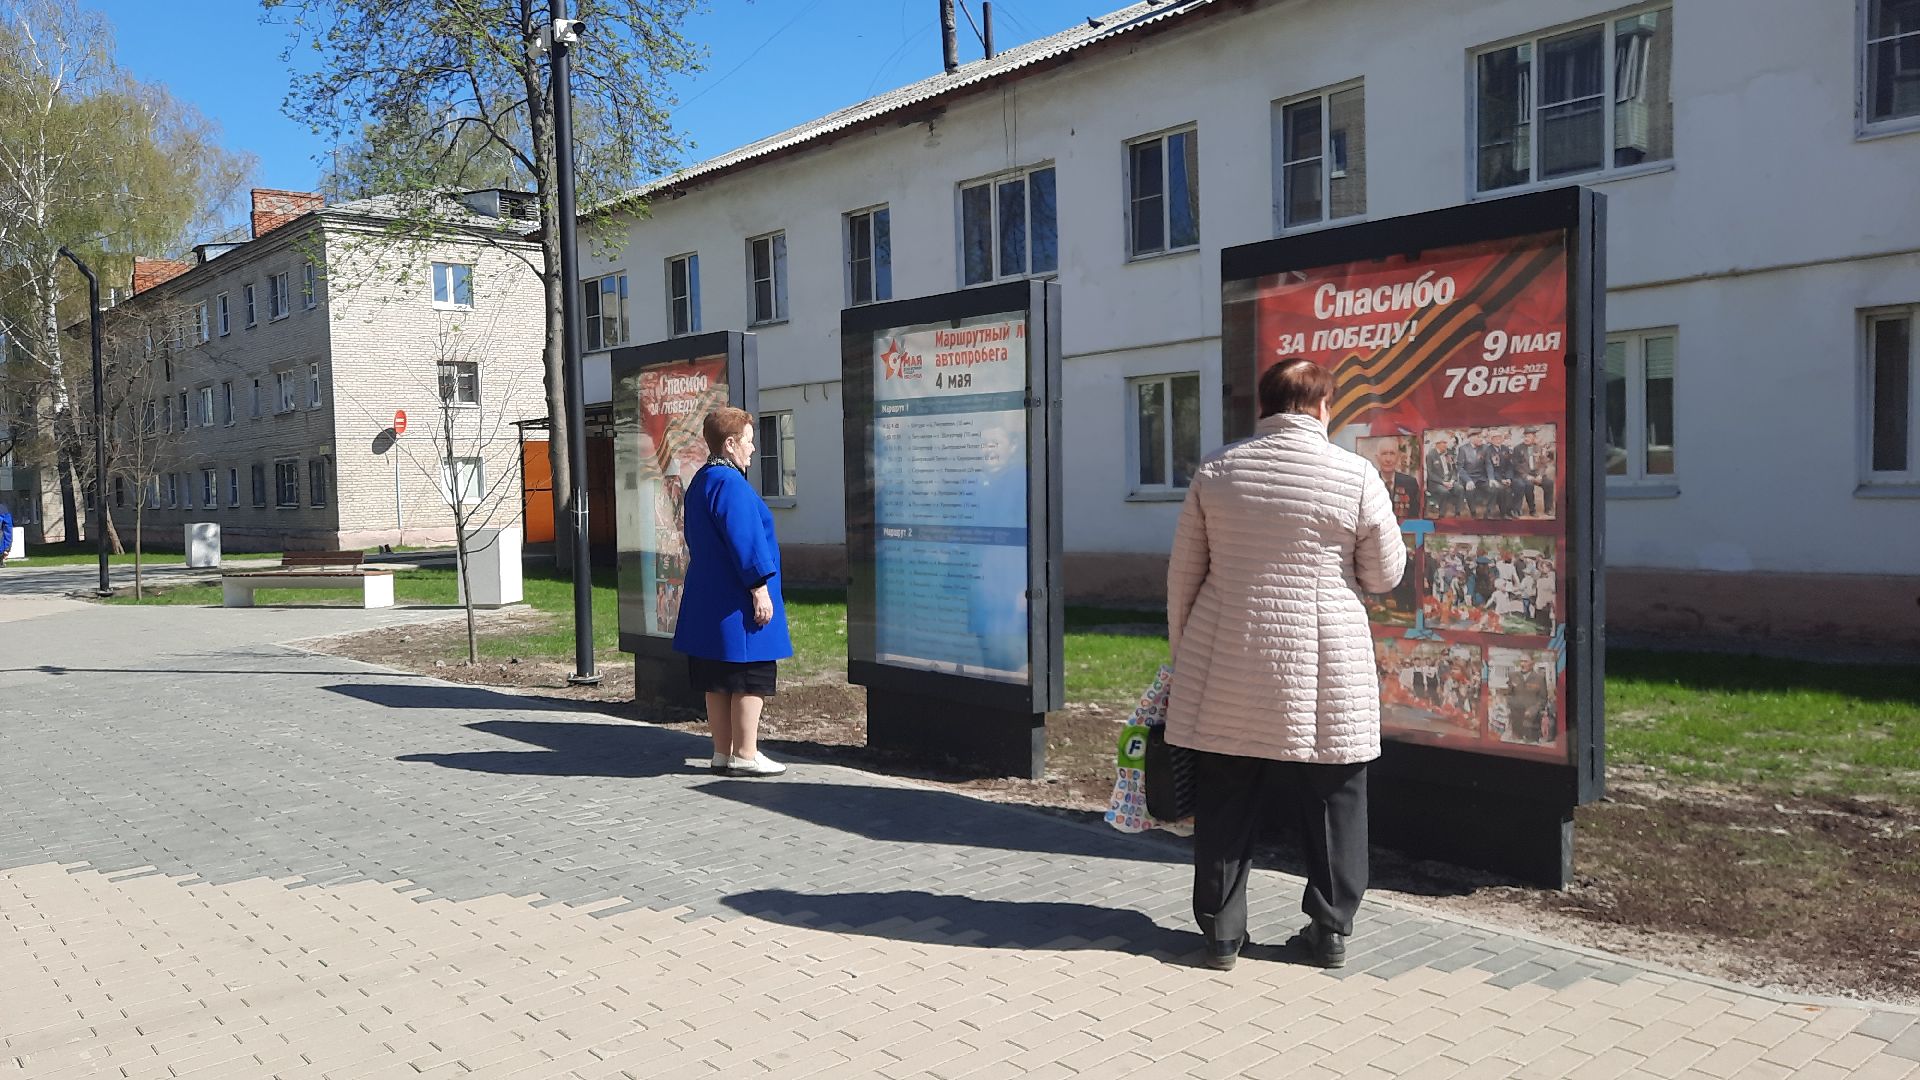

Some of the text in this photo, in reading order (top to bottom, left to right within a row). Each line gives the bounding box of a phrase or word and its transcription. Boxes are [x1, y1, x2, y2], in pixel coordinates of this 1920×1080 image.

[1314, 270, 1455, 320] Спасибо
[935, 323, 1010, 349] Маршрутный
[1277, 320, 1418, 355] ЗА ПОБЕДУ!
[1482, 330, 1561, 361] 9 МАЯ
[935, 346, 1008, 368] автопробега
[660, 372, 707, 396] Спасибо
[935, 372, 942, 389] 4
[948, 373, 971, 388] мая
[883, 527, 906, 539] Маршрут
[908, 528, 913, 537] 2
[1128, 740, 1142, 755] F
